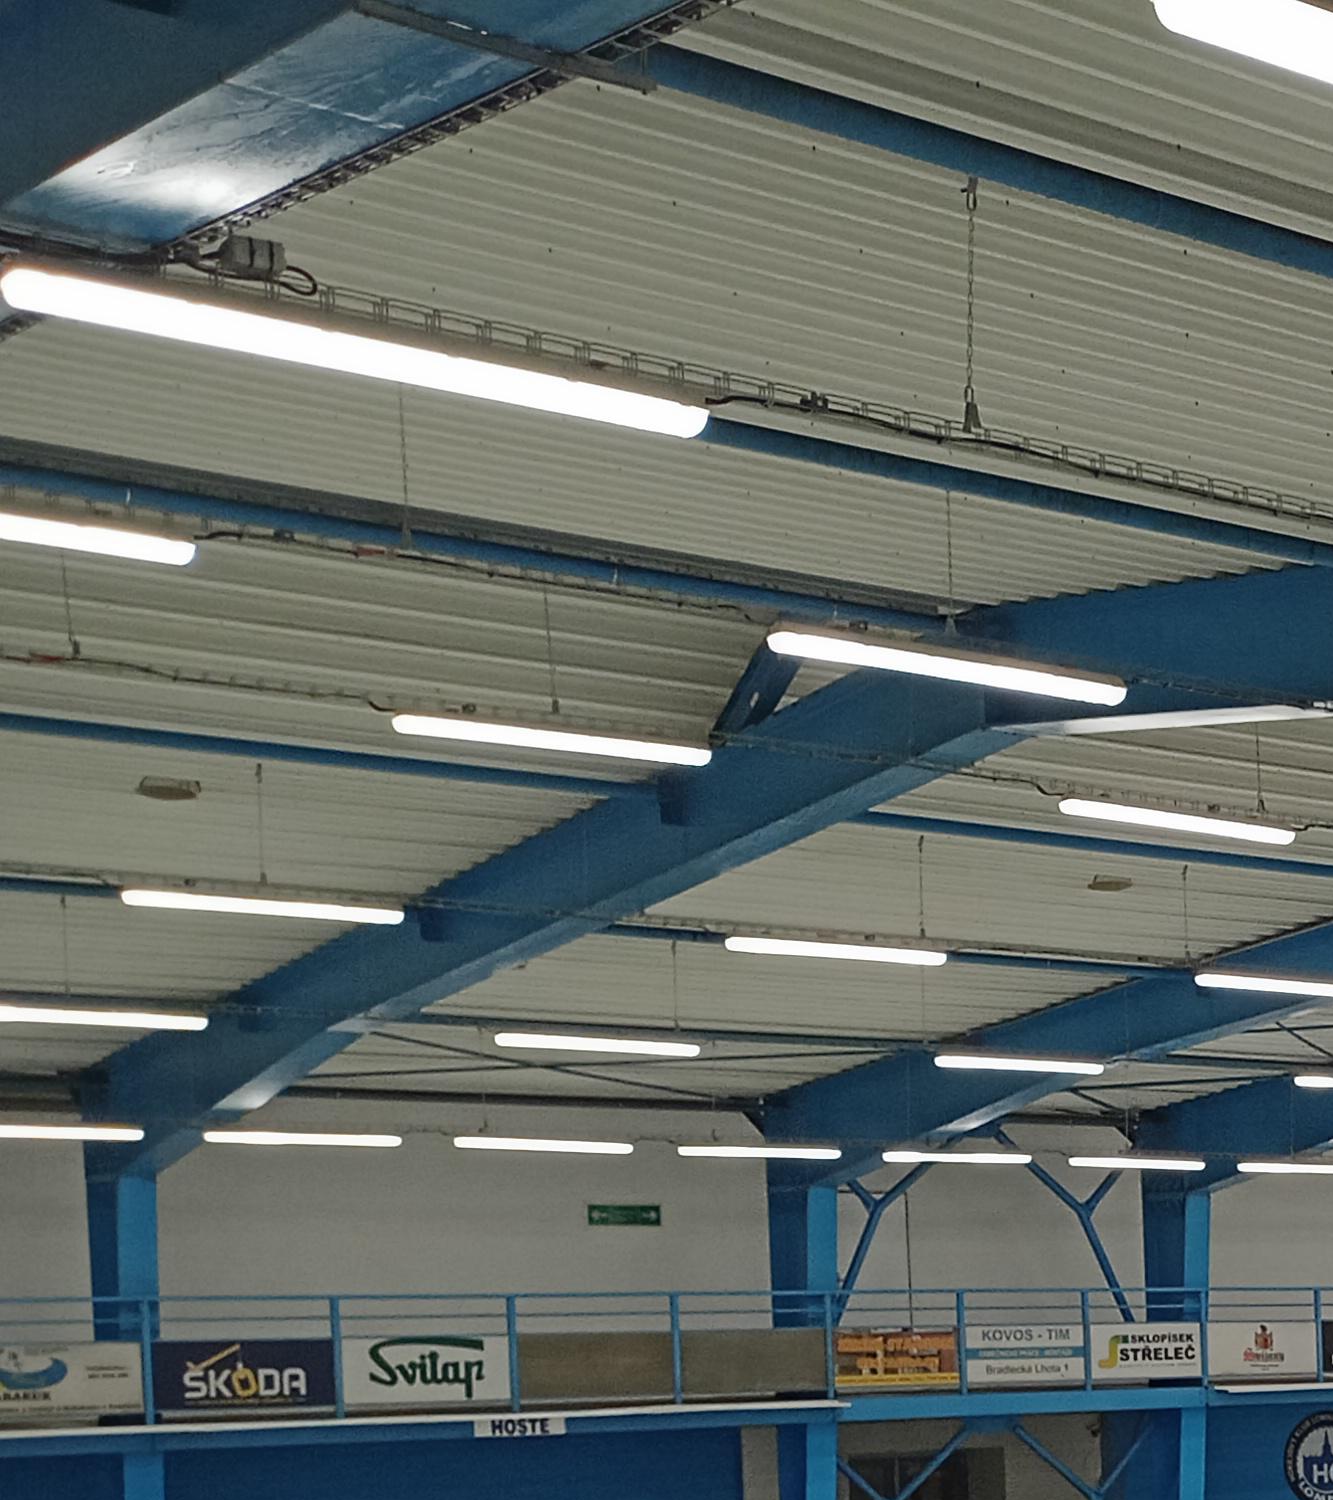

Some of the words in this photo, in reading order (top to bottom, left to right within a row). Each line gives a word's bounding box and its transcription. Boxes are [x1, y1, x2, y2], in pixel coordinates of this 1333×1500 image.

[982, 1329, 1033, 1342] KOVOS
[1049, 1328, 1071, 1340] TIM
[1120, 1346, 1195, 1362] STŘELEČ
[184, 1362, 307, 1398] ŠKODA
[491, 1418, 549, 1435] HOSTE
